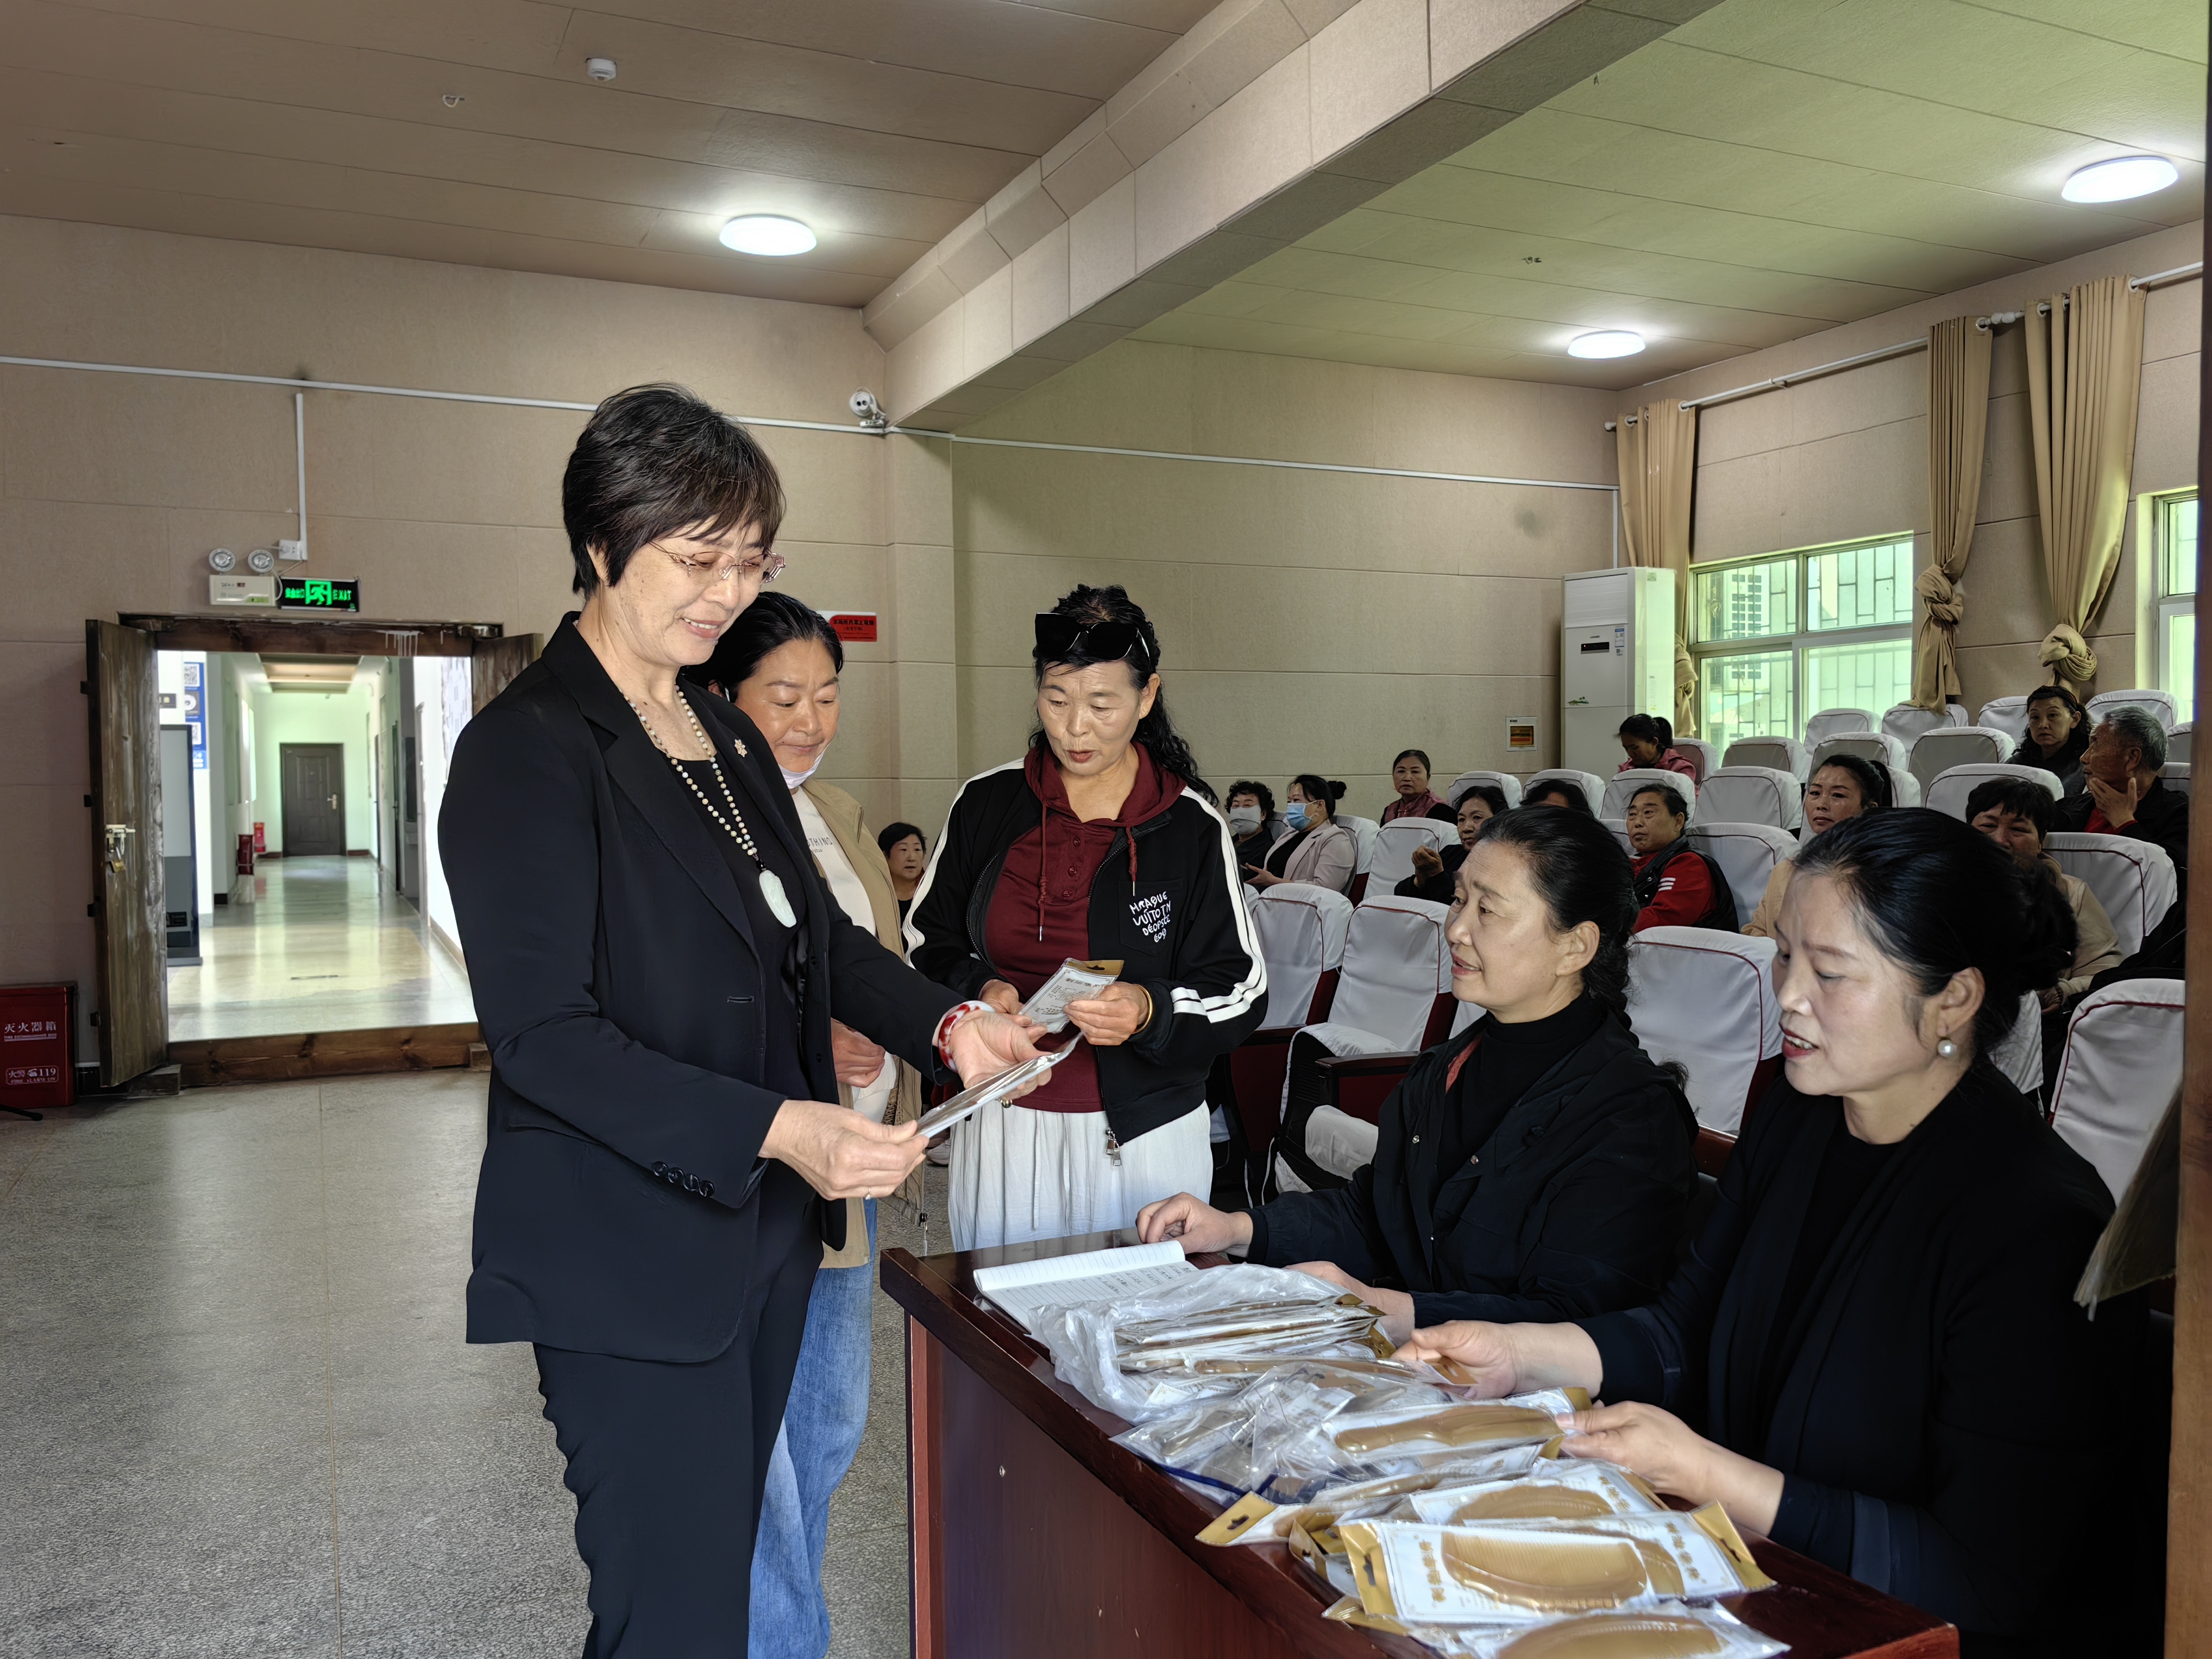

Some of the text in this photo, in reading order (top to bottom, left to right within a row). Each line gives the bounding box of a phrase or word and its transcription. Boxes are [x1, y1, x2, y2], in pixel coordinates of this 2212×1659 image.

[332, 589, 352, 601] EXIT
[4, 1021, 56, 1034] 灭火器箱
[39, 1068, 56, 1077] 119
